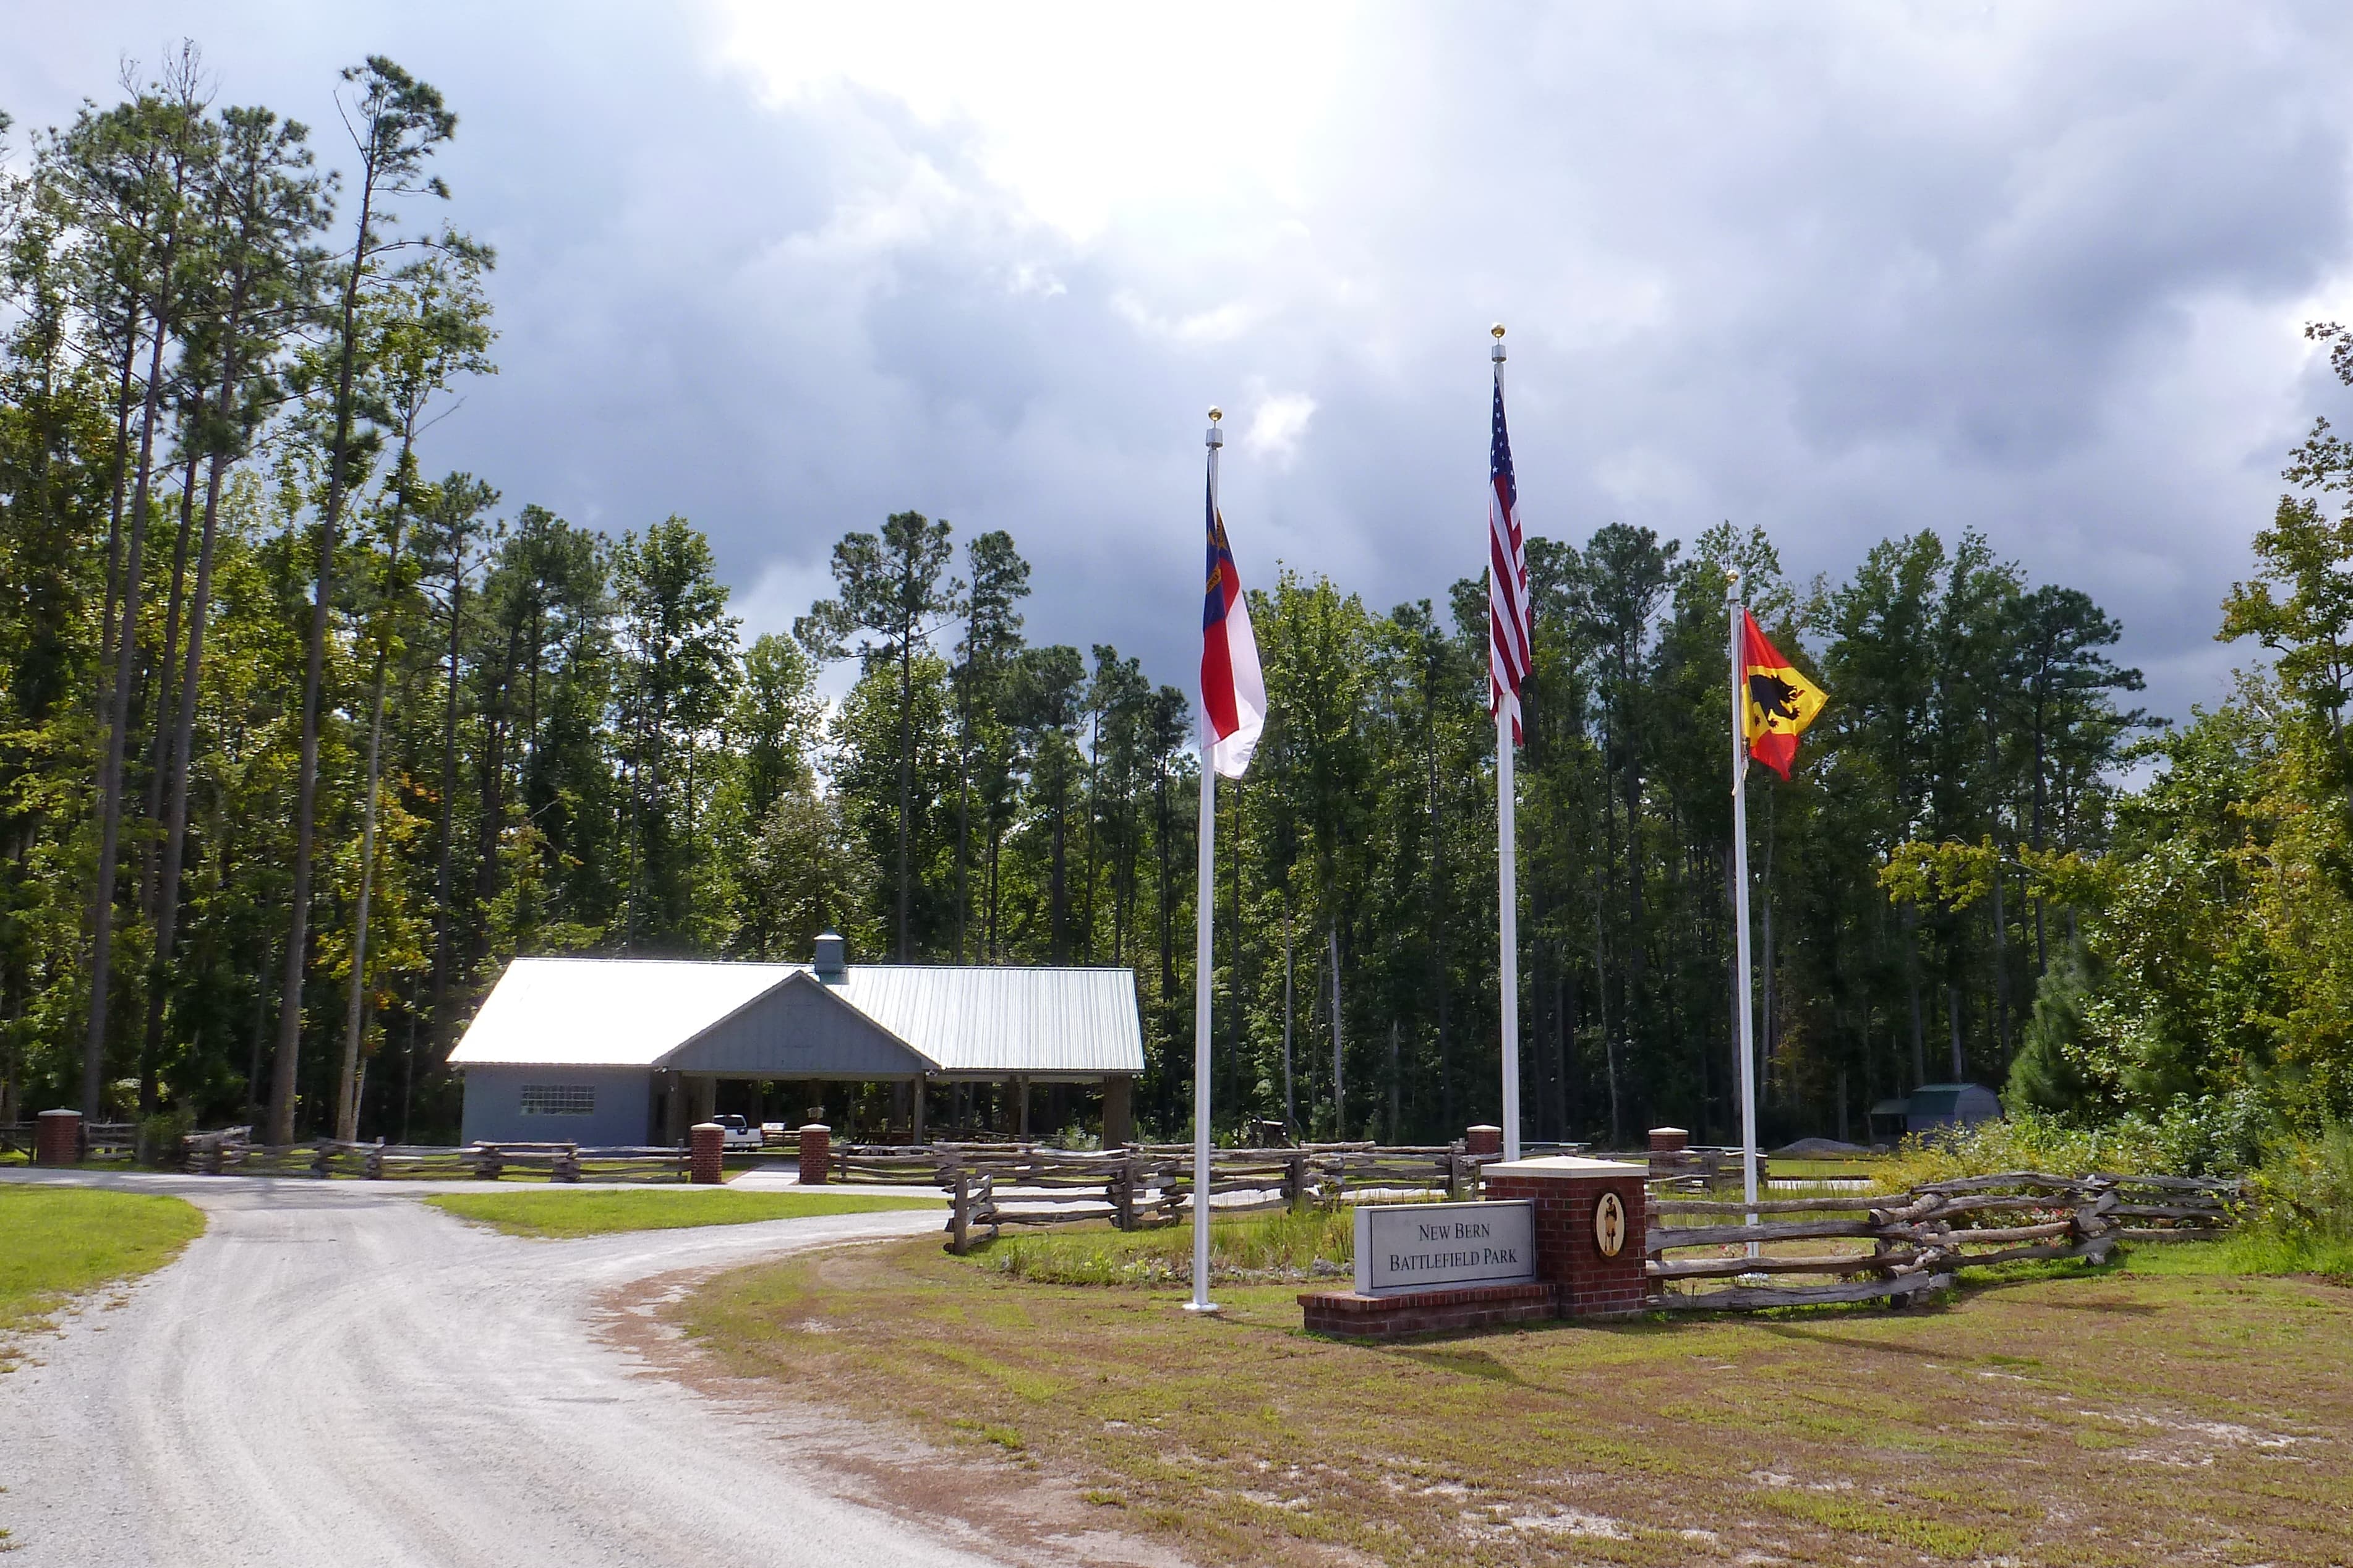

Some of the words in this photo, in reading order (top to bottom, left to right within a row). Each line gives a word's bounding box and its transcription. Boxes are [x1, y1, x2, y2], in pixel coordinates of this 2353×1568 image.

[1419, 1224, 1450, 1241] NEW
[1455, 1222, 1490, 1238] BERN
[1390, 1251, 1480, 1271] BATTLEFIELD
[1484, 1248, 1518, 1264] PARK
